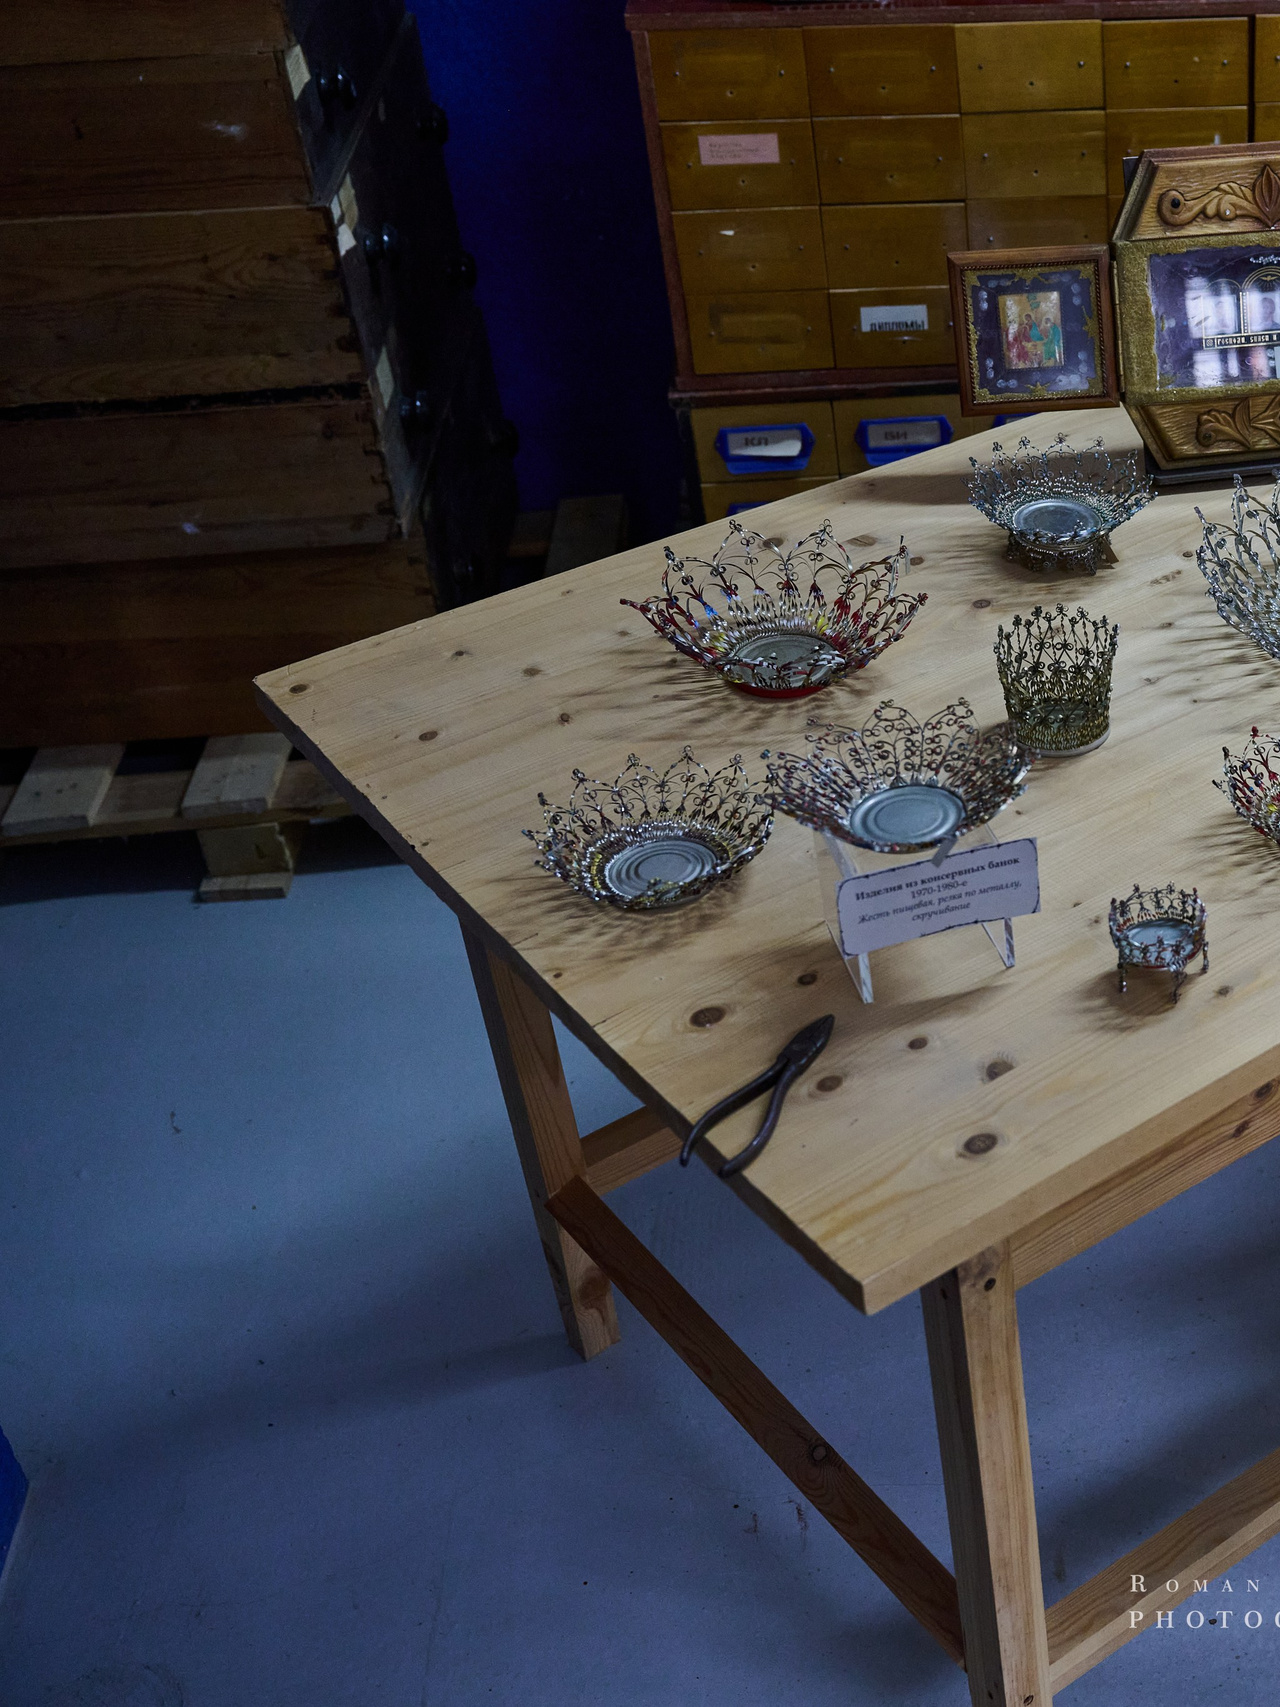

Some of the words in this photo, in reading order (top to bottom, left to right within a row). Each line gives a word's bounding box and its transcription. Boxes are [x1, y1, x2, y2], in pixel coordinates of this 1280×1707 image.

[855, 884, 903, 901] Изделия
[905, 879, 918, 890] из
[921, 865, 986, 885] консервных
[988, 856, 1020, 870] банок
[858, 911, 890, 925] Жесть
[937, 892, 963, 907] резка
[964, 889, 977, 899] по
[911, 902, 971, 922] скручивание
